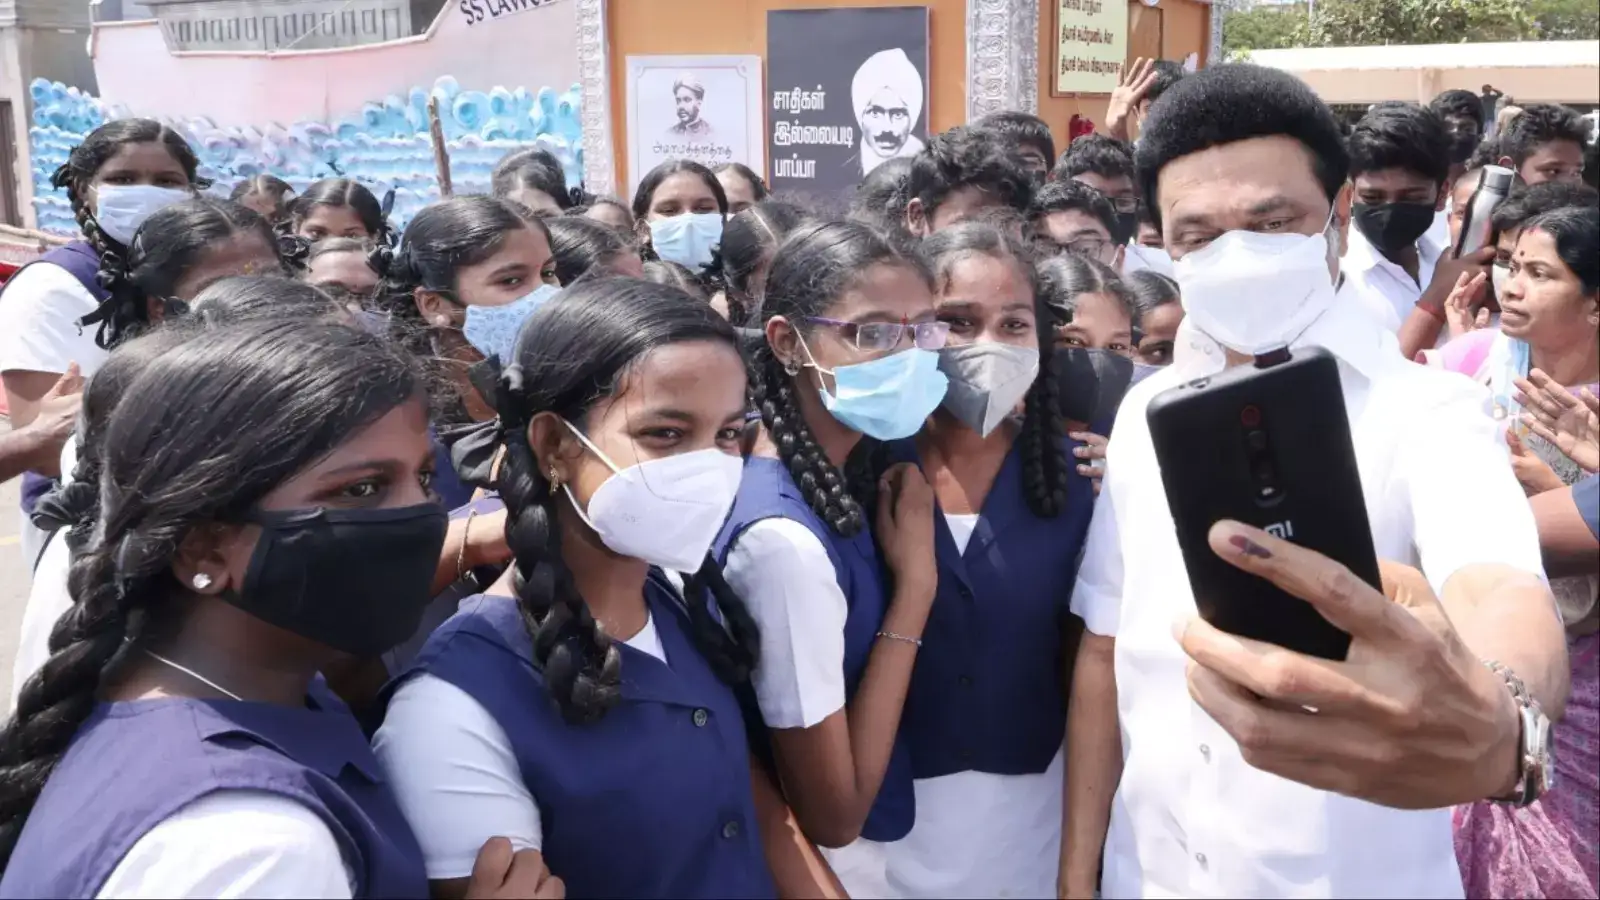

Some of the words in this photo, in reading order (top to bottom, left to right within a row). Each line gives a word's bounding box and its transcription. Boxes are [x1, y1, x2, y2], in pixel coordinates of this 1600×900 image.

[460, 0, 484, 25] SS
[486, 0, 552, 17] LAW
[773, 84, 826, 114] சாதிகள்
[774, 119, 854, 149] இல்லையடி
[774, 153, 817, 178] பாப்பா
